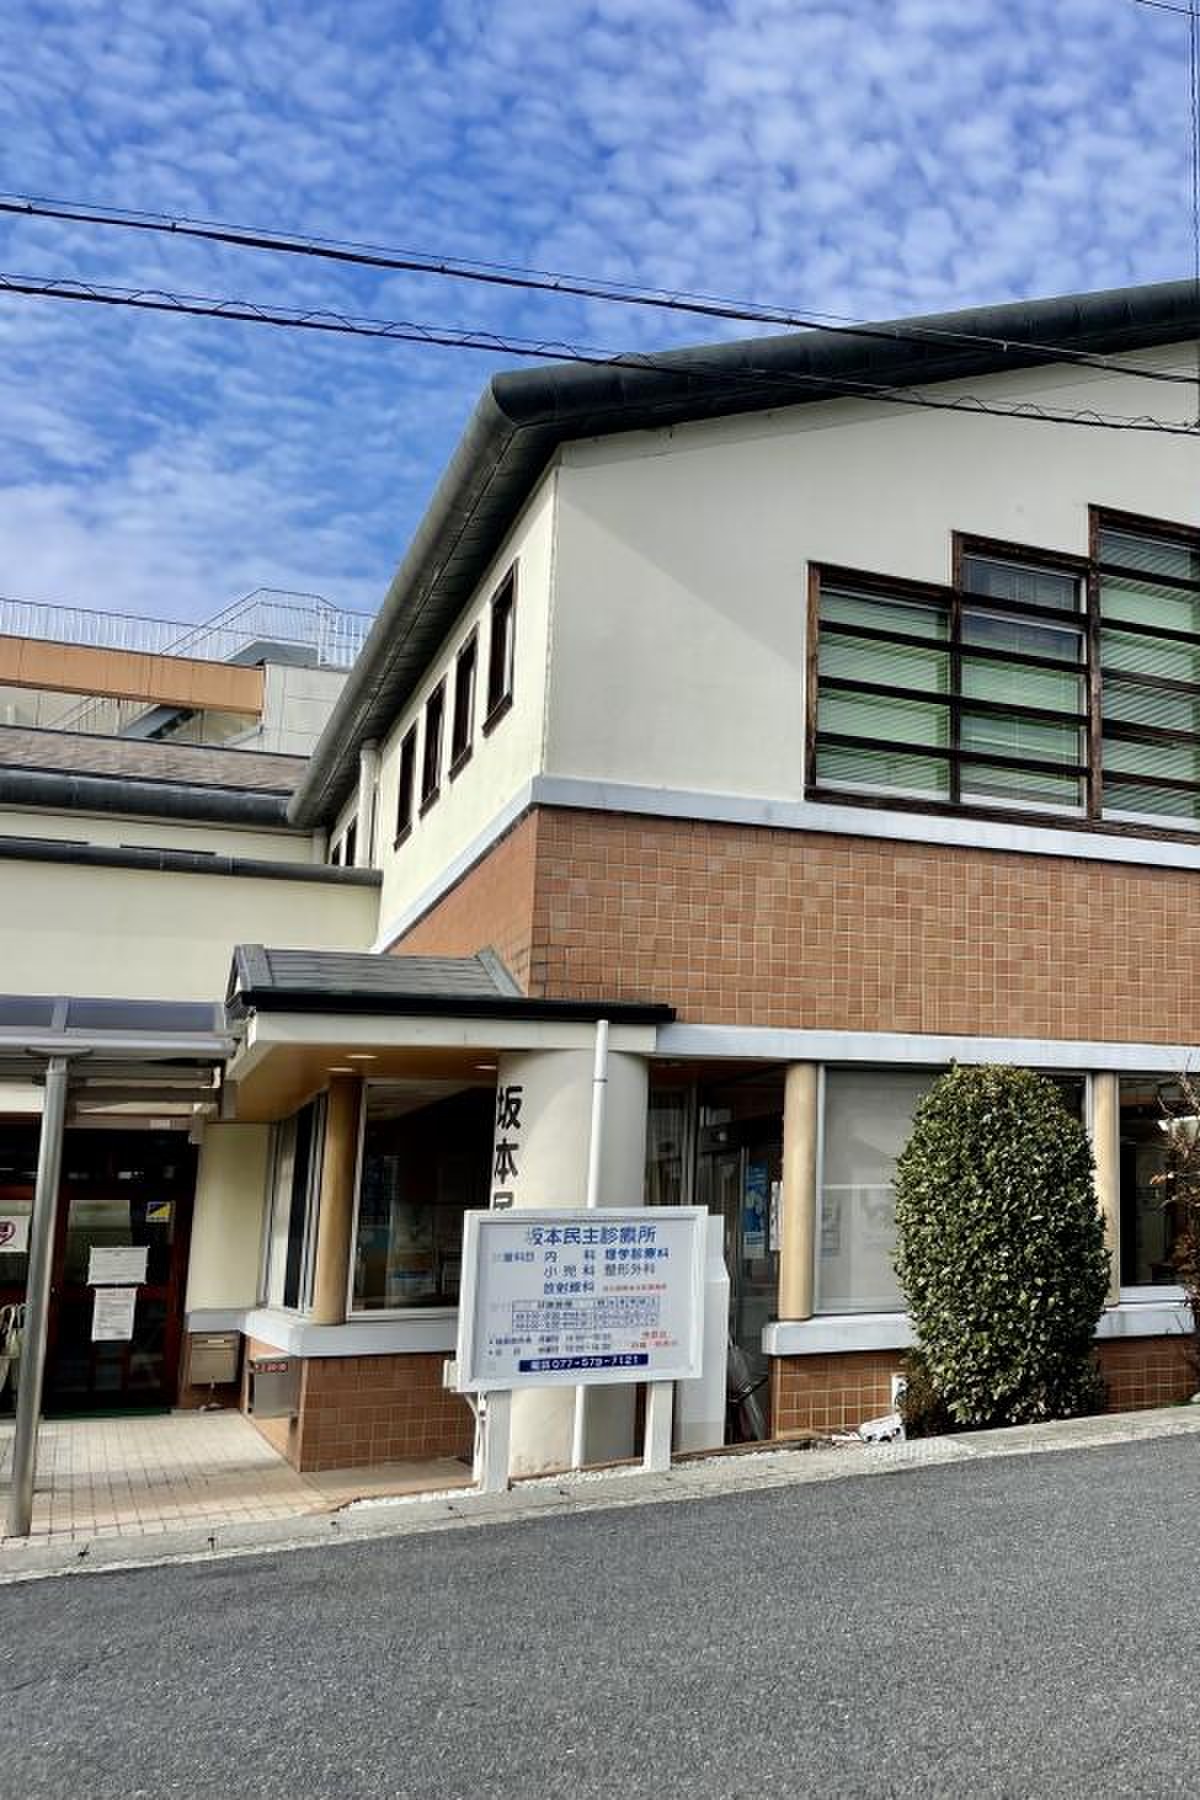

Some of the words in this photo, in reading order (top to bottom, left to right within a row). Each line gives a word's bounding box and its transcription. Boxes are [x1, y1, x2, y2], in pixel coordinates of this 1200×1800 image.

[527, 1225, 656, 1246] 坂本民主診療所
